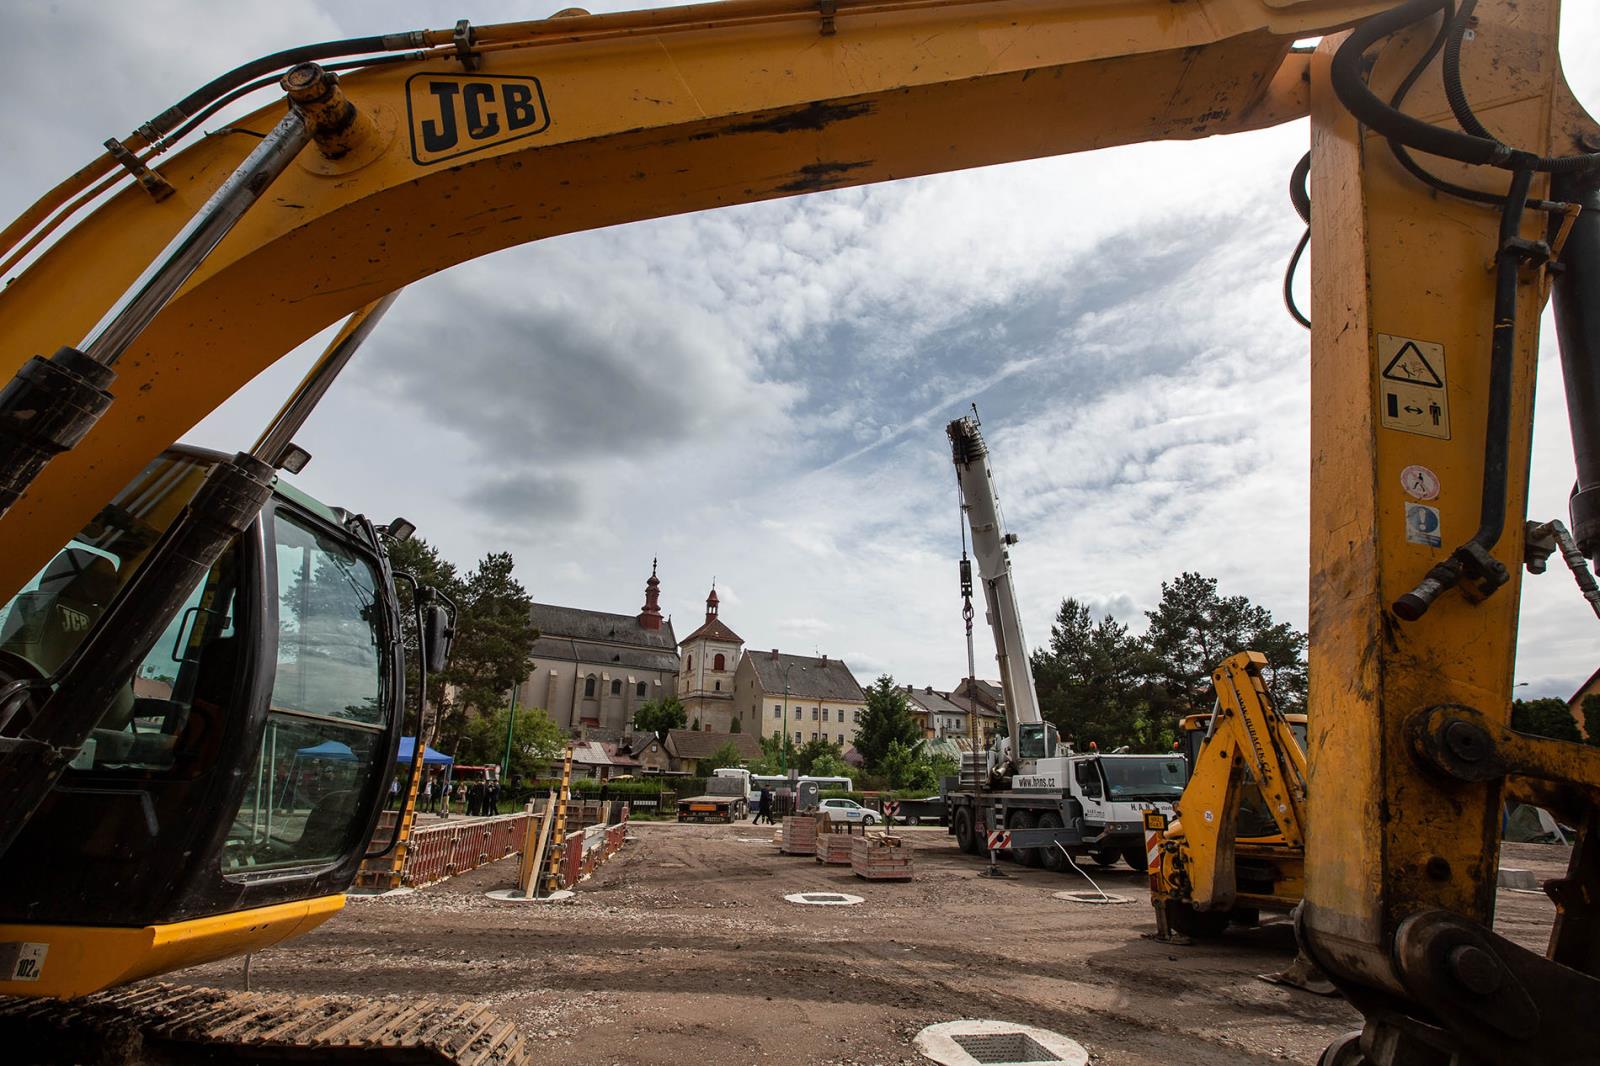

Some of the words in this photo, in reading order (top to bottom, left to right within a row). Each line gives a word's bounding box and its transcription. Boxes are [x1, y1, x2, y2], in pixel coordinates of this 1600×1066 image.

[421, 81, 537, 153] JCB
[62, 609, 89, 632] JCB
[17, 958, 36, 977] 102
